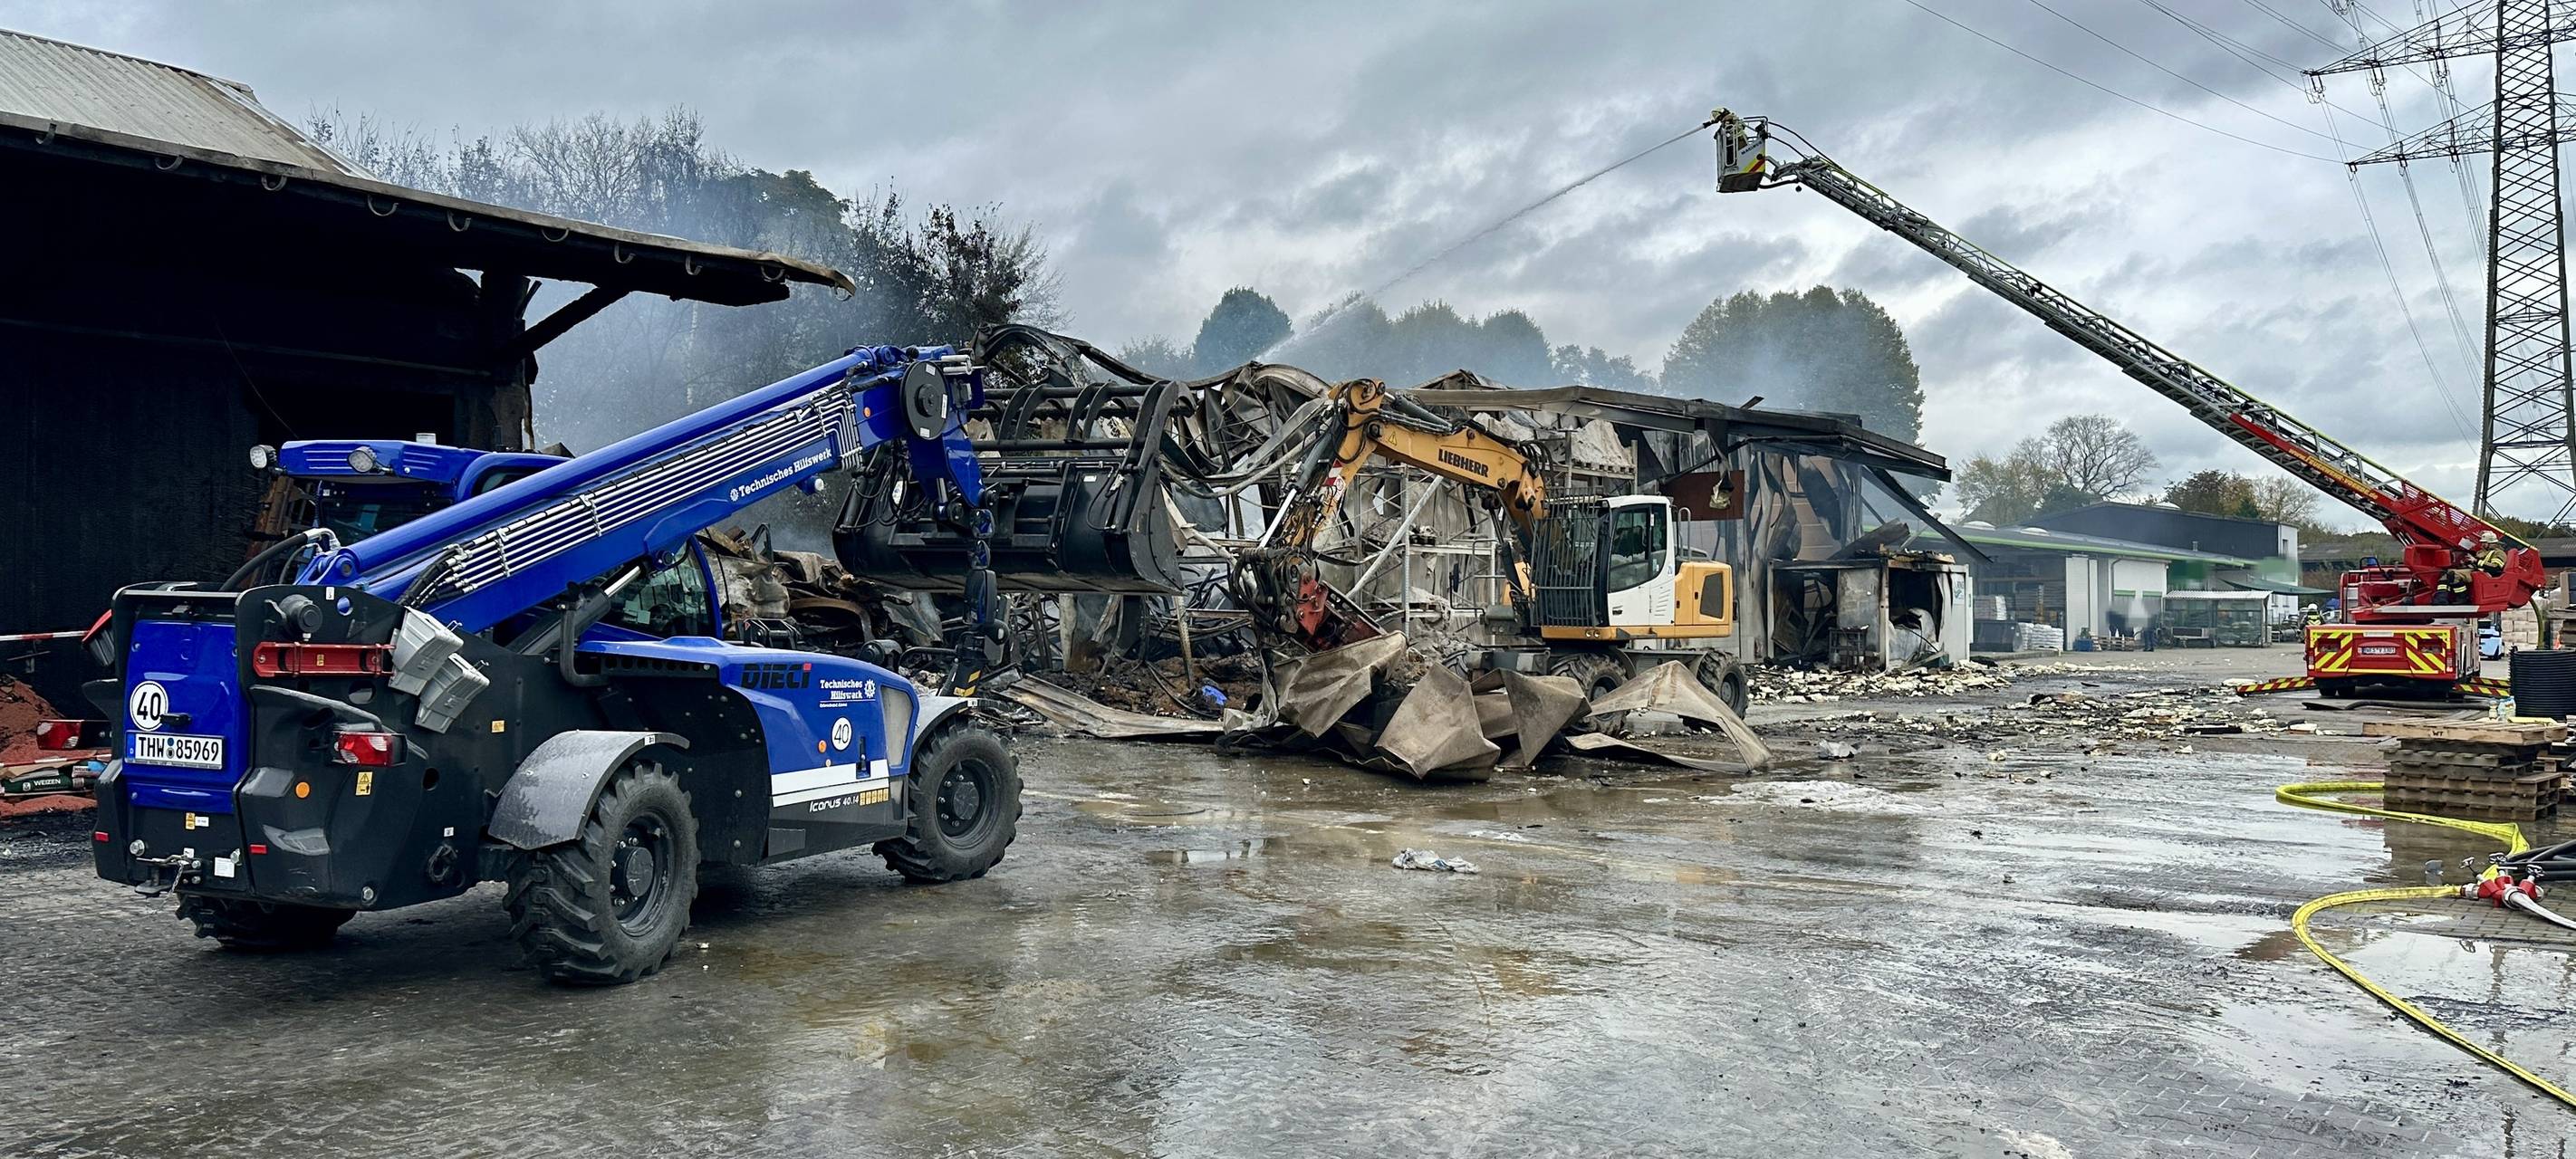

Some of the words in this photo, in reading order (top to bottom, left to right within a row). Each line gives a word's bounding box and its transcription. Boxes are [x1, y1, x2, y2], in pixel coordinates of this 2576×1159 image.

[738, 465, 793, 497] Technisches
[793, 447, 832, 473] Hilfswerk
[1437, 448, 1489, 477] LIEBHERR
[820, 679, 863, 688] Technisches
[137, 692, 161, 721] 40
[833, 723, 850, 744] 40
[139, 737, 166, 757] THW
[176, 739, 219, 761] 85969
[34, 778, 62, 787] WEIZEN
